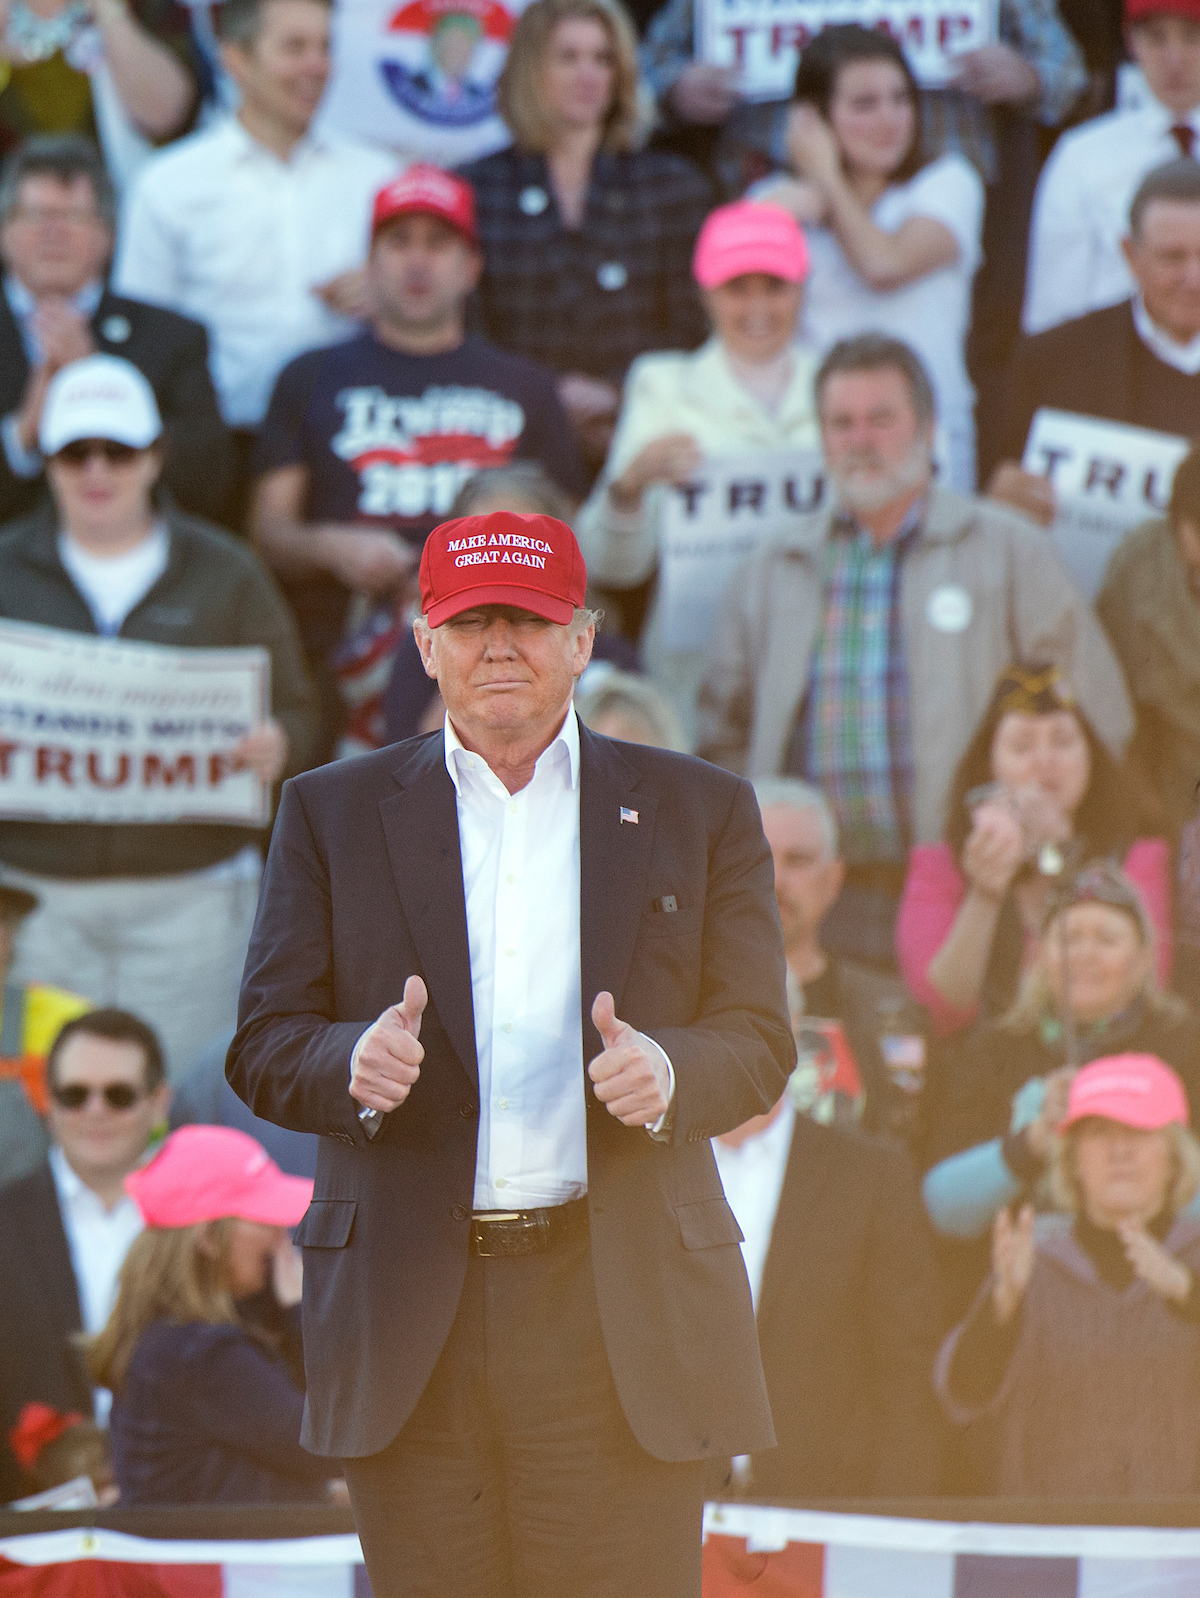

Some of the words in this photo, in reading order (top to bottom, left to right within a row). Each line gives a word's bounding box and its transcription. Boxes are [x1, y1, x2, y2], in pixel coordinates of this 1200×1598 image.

[724, 15, 972, 70] TRMP
[357, 464, 475, 516] 201
[673, 474, 828, 519] TRU
[447, 534, 487, 552] MAKE
[487, 533, 554, 554] AMERICA
[454, 550, 500, 568] GREAT
[501, 551, 546, 569] AGAIN
